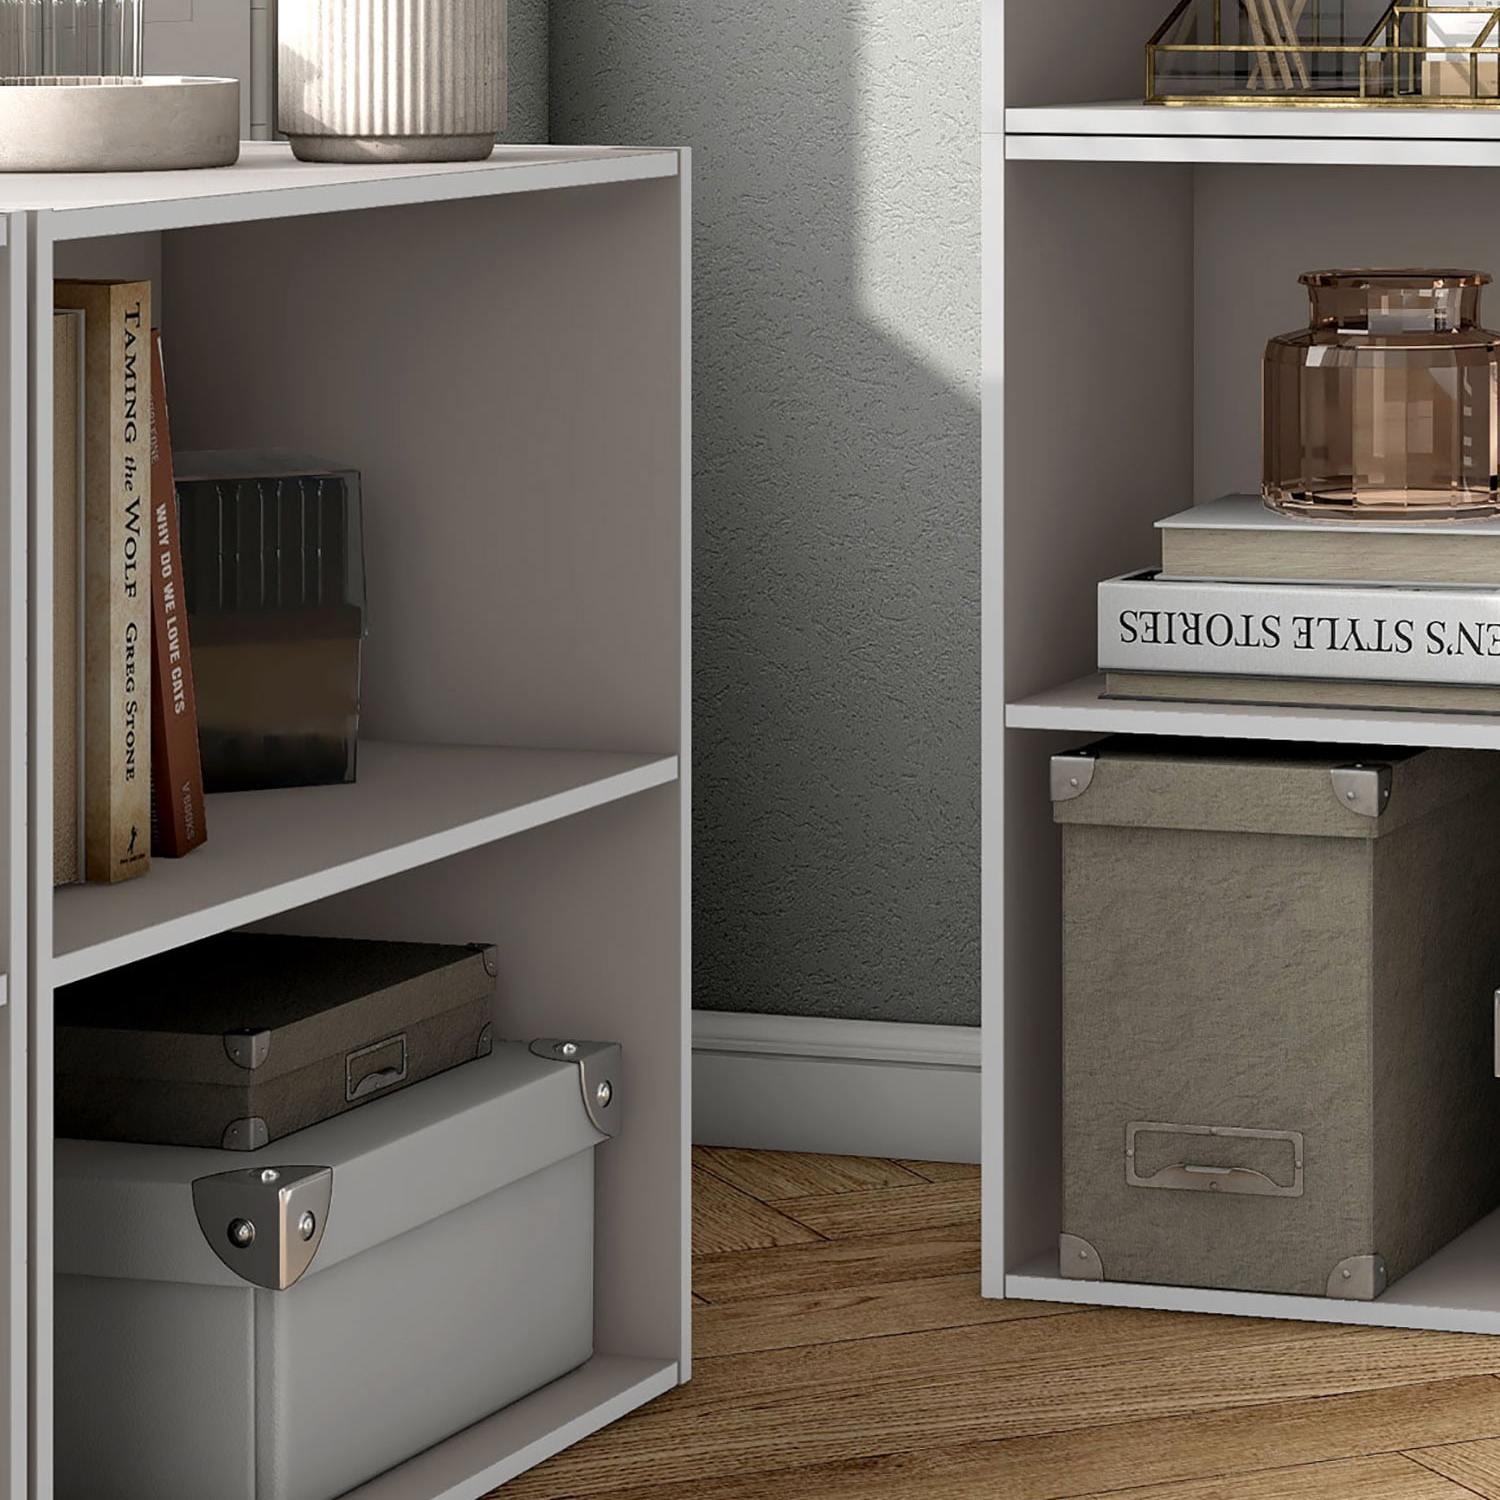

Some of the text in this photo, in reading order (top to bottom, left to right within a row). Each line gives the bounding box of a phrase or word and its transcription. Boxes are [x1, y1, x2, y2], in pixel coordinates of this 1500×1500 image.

[124, 302, 141, 781] TAMING the WOLF GREG STONE
[156, 502, 186, 715] WHY DO WE LOVE CATS
[1118, 609, 1281, 648] STORIES
[1294, 616, 1414, 654] STYLE
